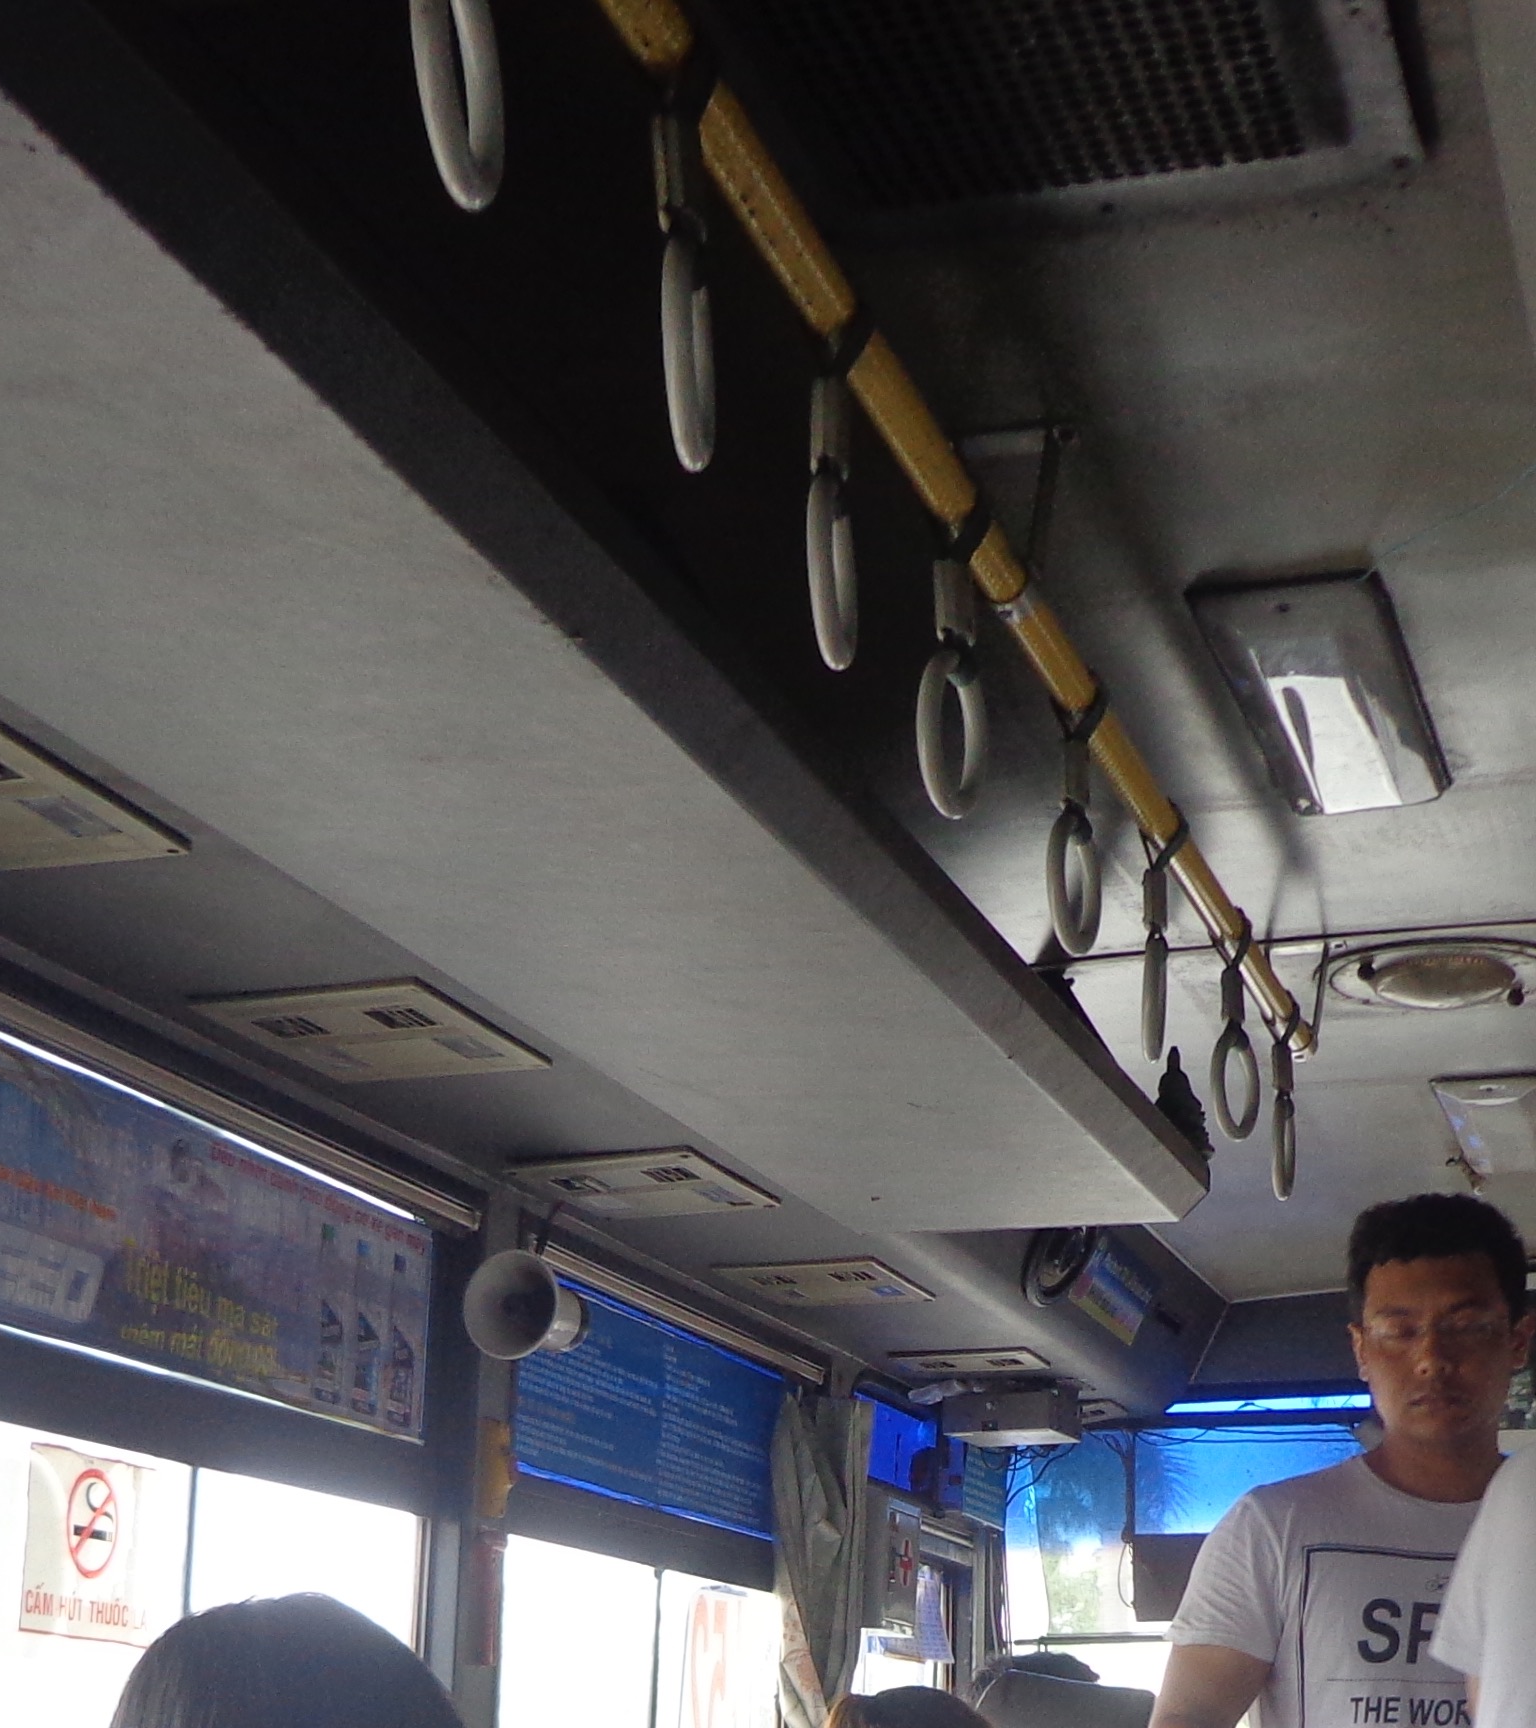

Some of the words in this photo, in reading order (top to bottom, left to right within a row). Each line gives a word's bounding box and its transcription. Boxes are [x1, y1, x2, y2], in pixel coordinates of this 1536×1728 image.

[25, 1583, 54, 1616] CẤM
[59, 1591, 82, 1621] HÚT
[89, 1599, 129, 1628] THUỐC
[1350, 1697, 1401, 1725] THE
[1409, 1698, 1472, 1726] WOR
